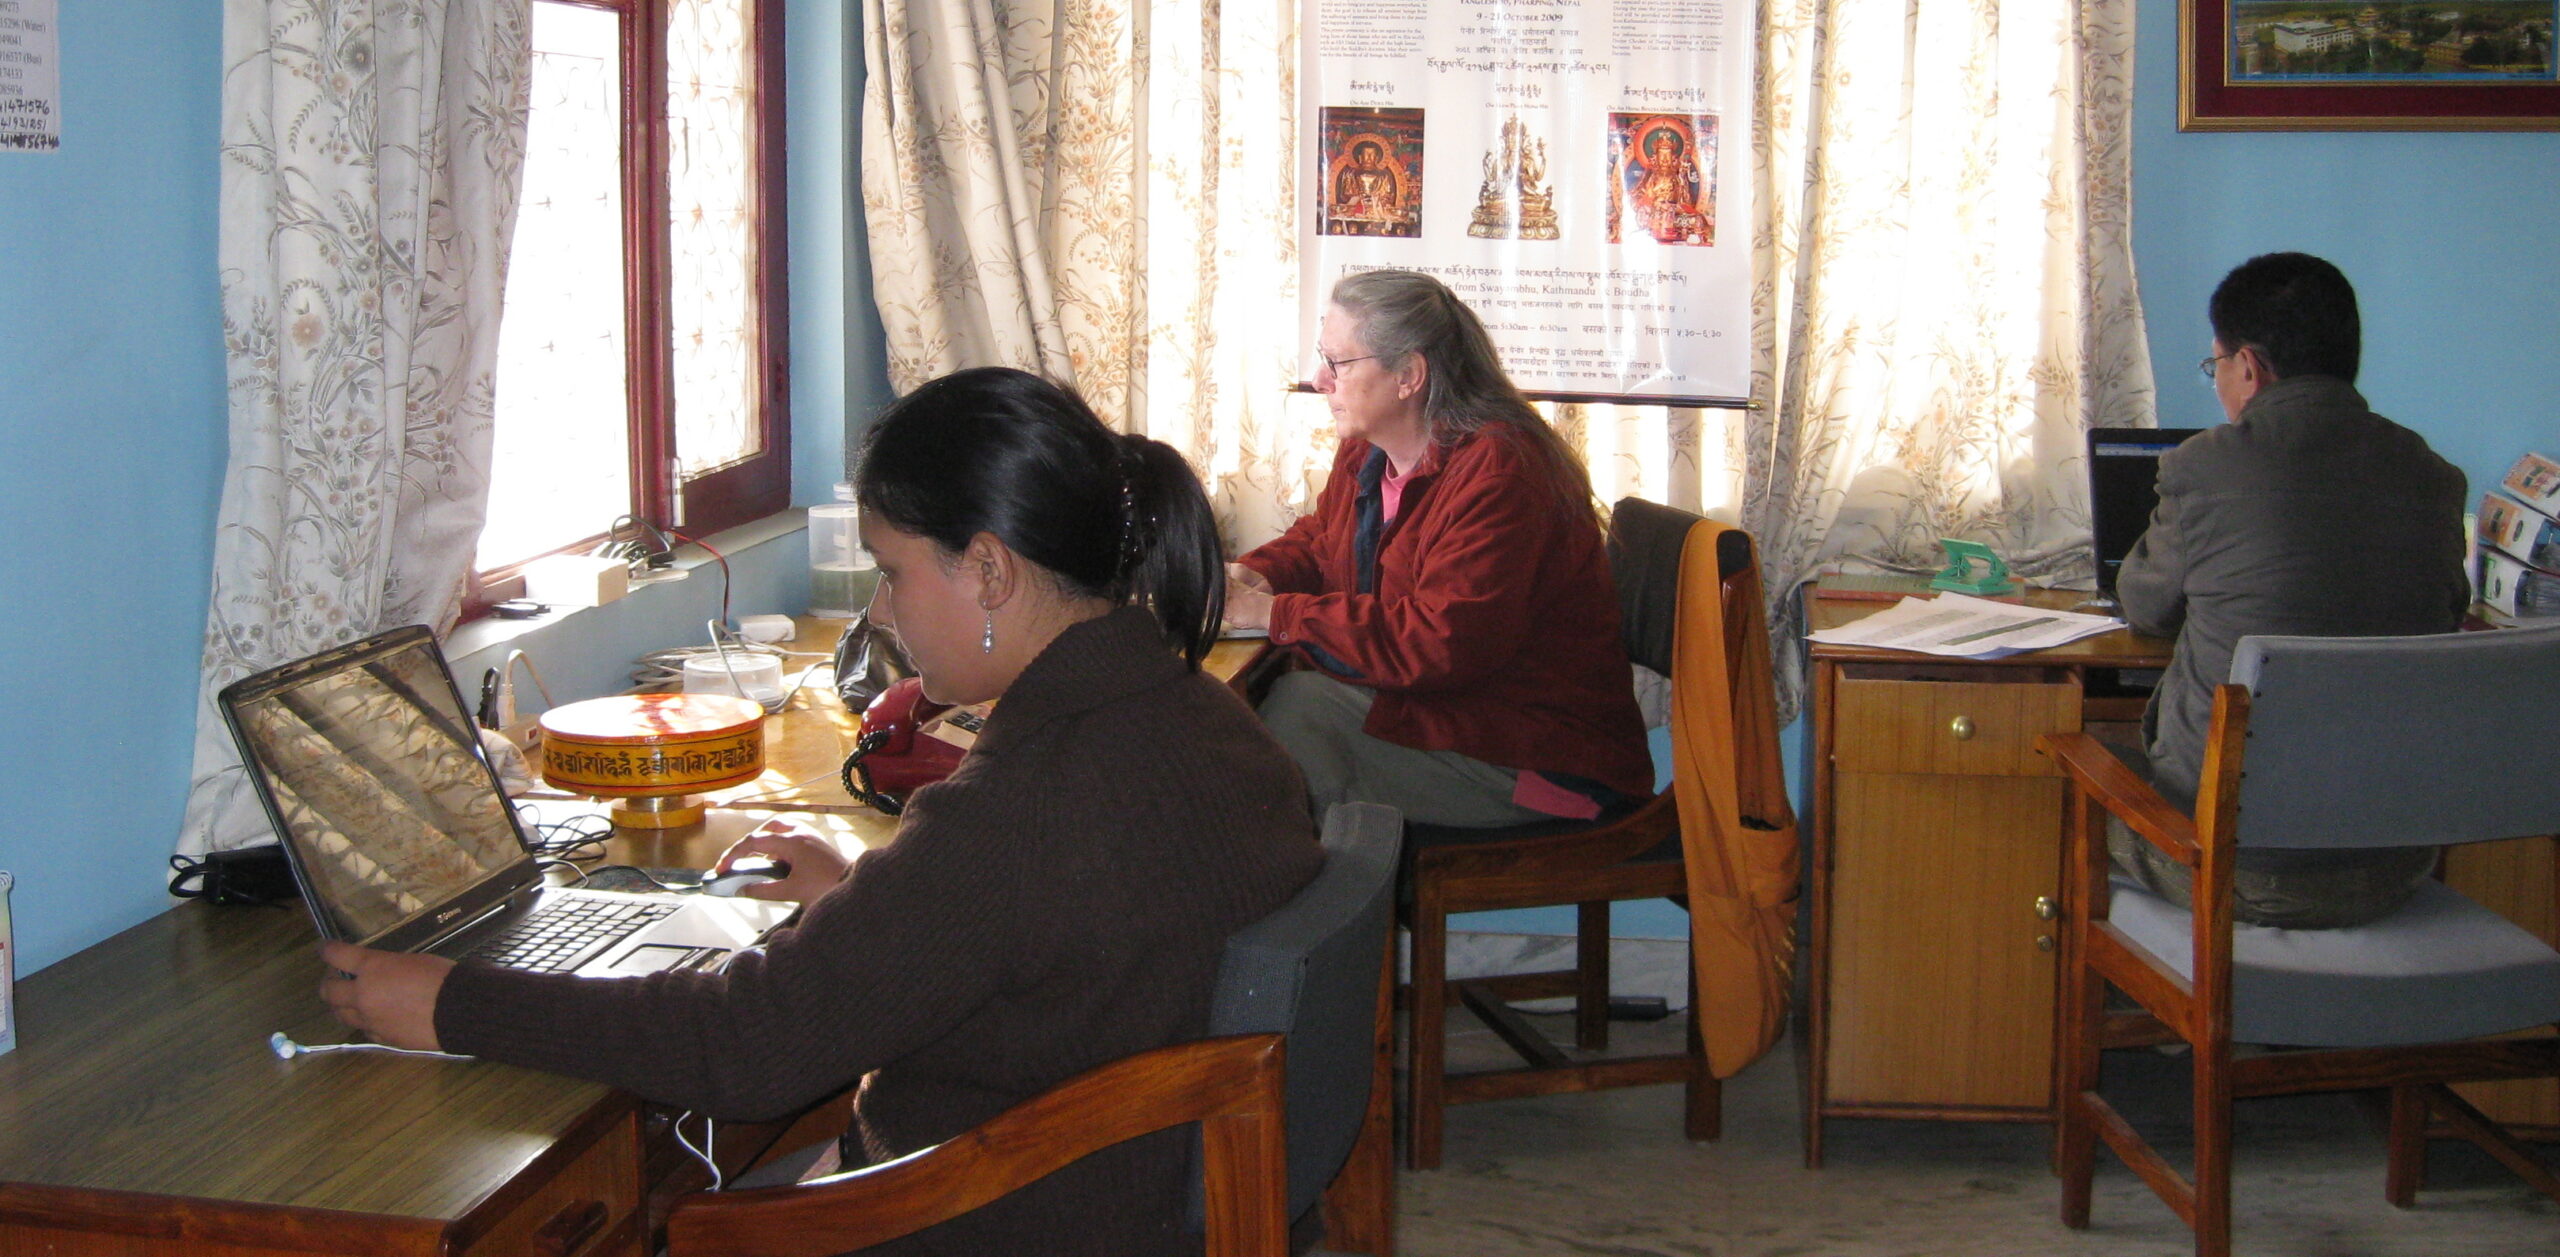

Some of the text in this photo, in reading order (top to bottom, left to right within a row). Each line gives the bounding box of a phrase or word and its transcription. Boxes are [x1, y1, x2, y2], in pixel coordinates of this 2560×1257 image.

[1476, 12, 1482, 21] 9
[1541, 13, 1564, 22] 2009
[1455, 281, 1477, 292] from
[1542, 284, 1596, 296] Kathmandu
[1500, 323, 1528, 331] 5:30am
[1540, 324, 1568, 332] 6:30am
